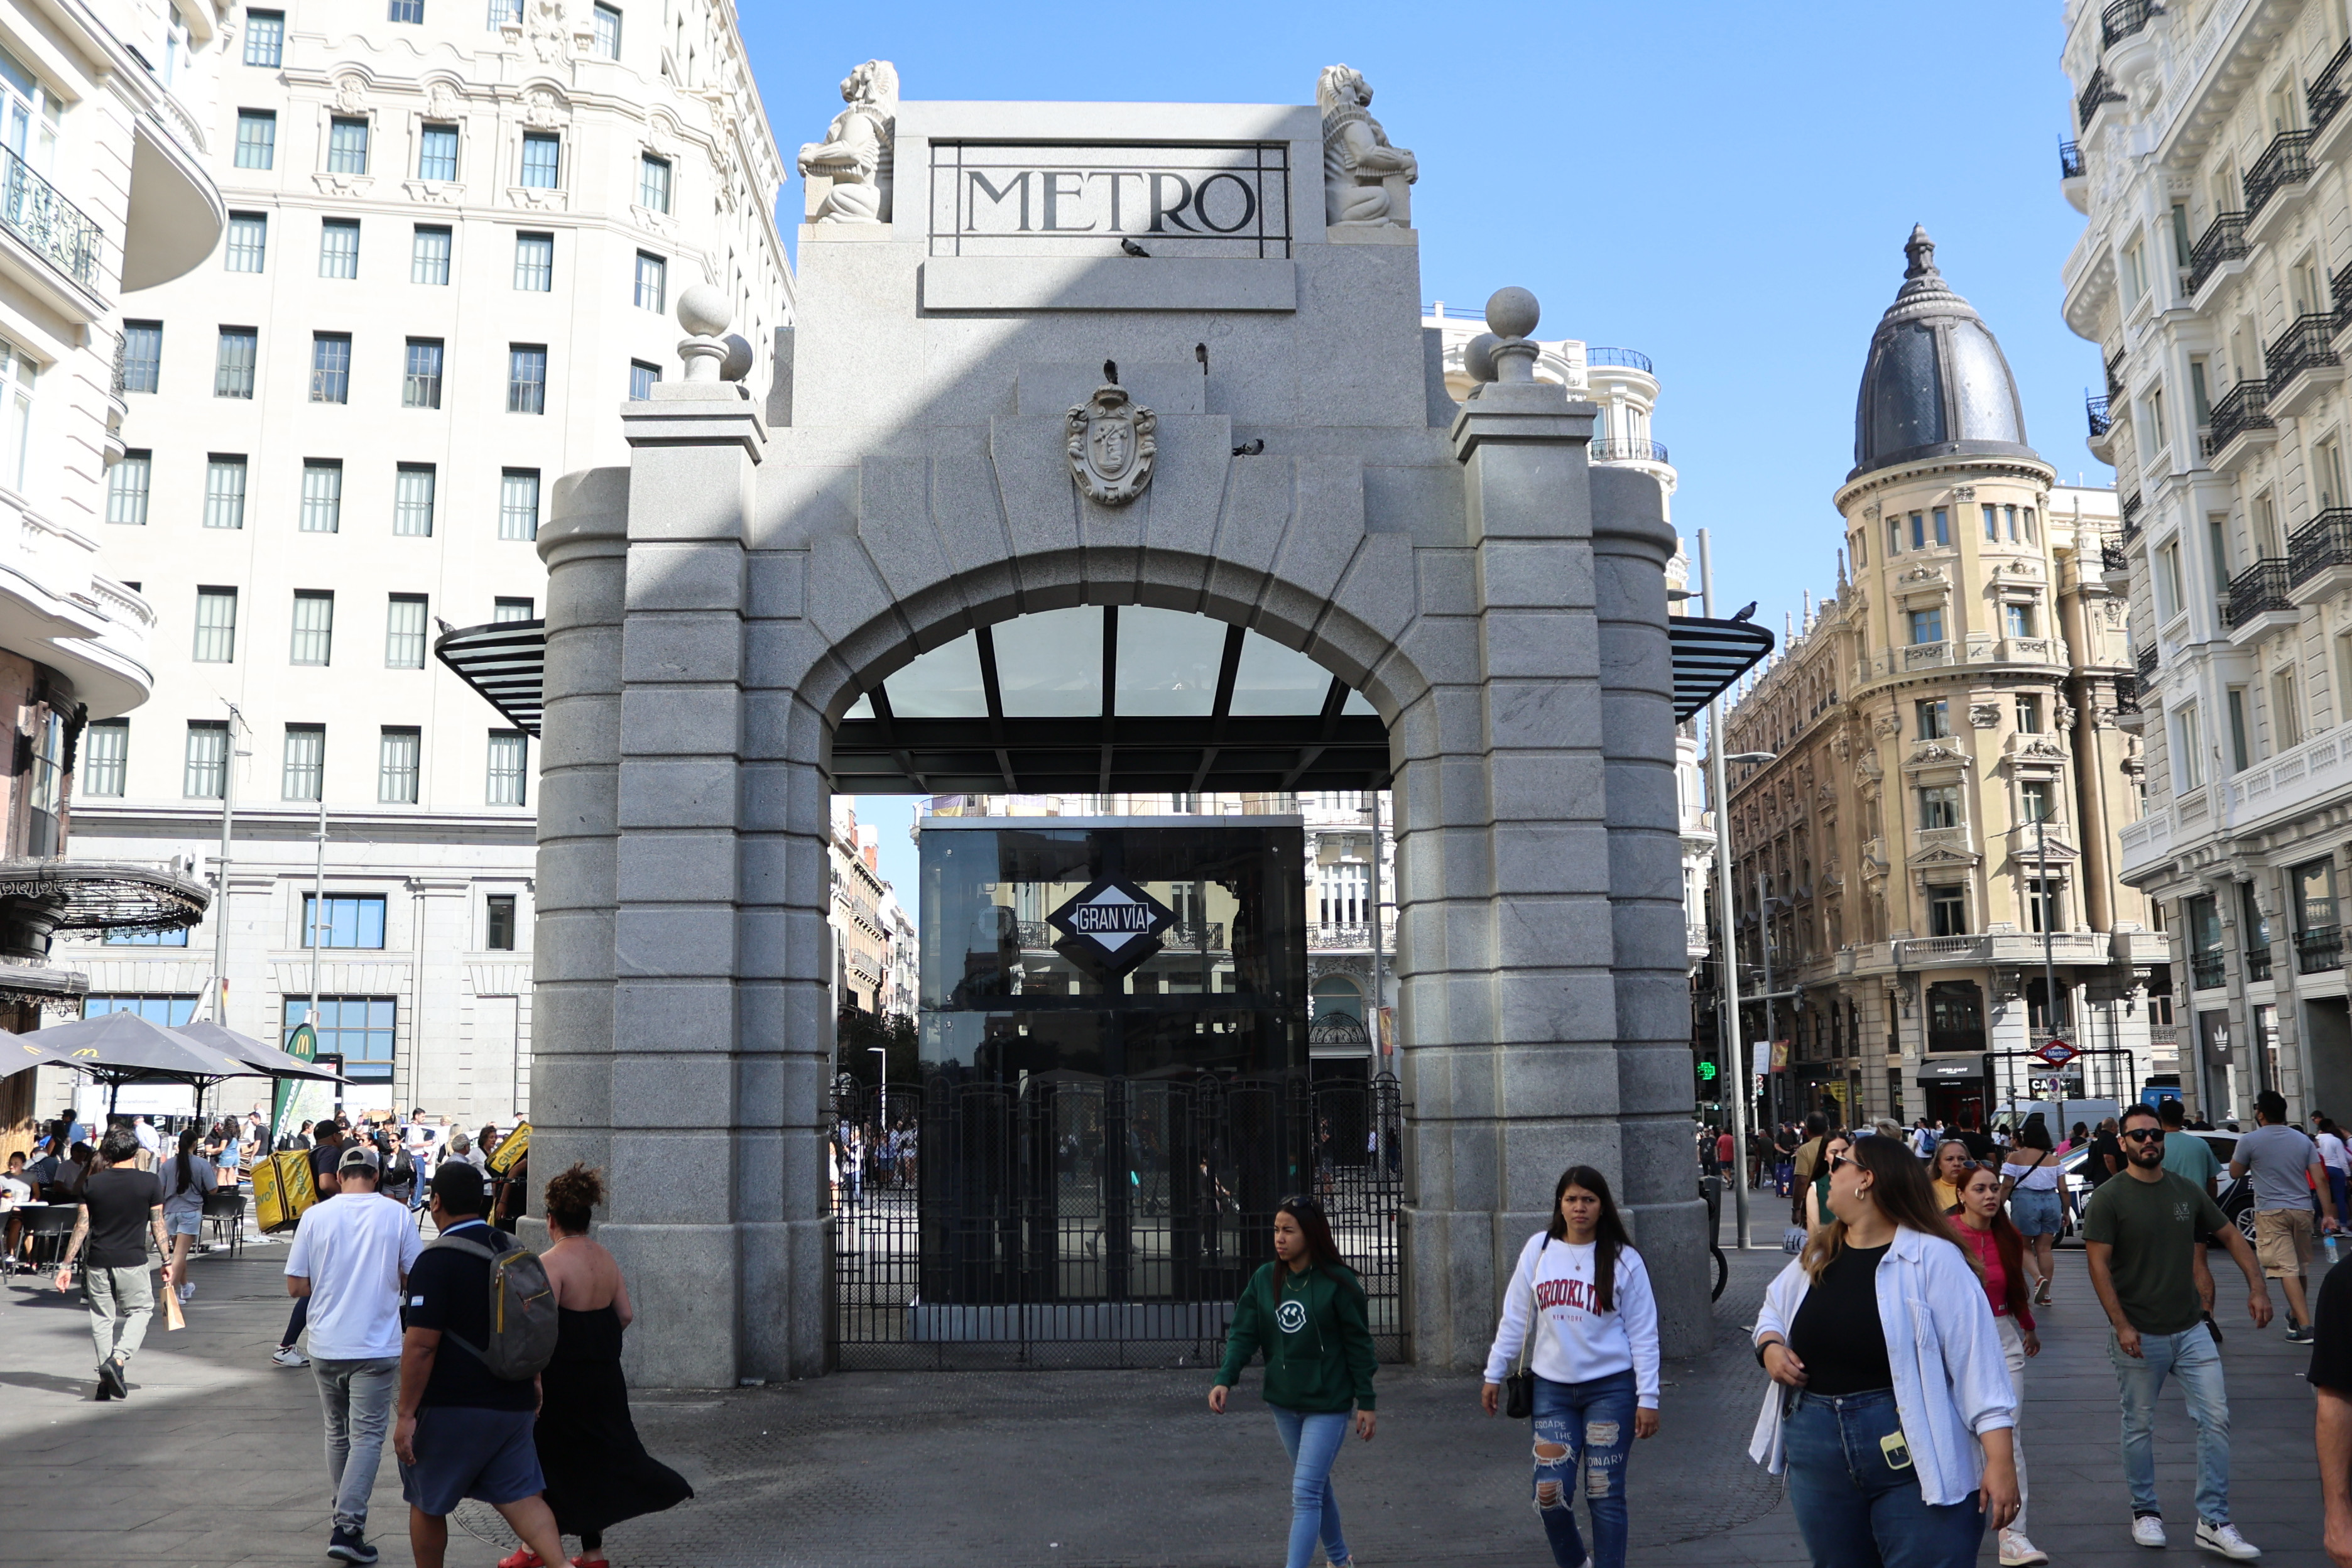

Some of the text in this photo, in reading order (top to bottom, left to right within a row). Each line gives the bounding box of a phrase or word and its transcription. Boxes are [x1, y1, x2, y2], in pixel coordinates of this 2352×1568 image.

[964, 170, 1256, 233] METRO
[1079, 904, 1146, 930] GRAN VÍA
[498, 1135, 528, 1166] Glovo
[1535, 1419, 1567, 1430] ESCAPE
[1554, 1432, 1572, 1440] THE
